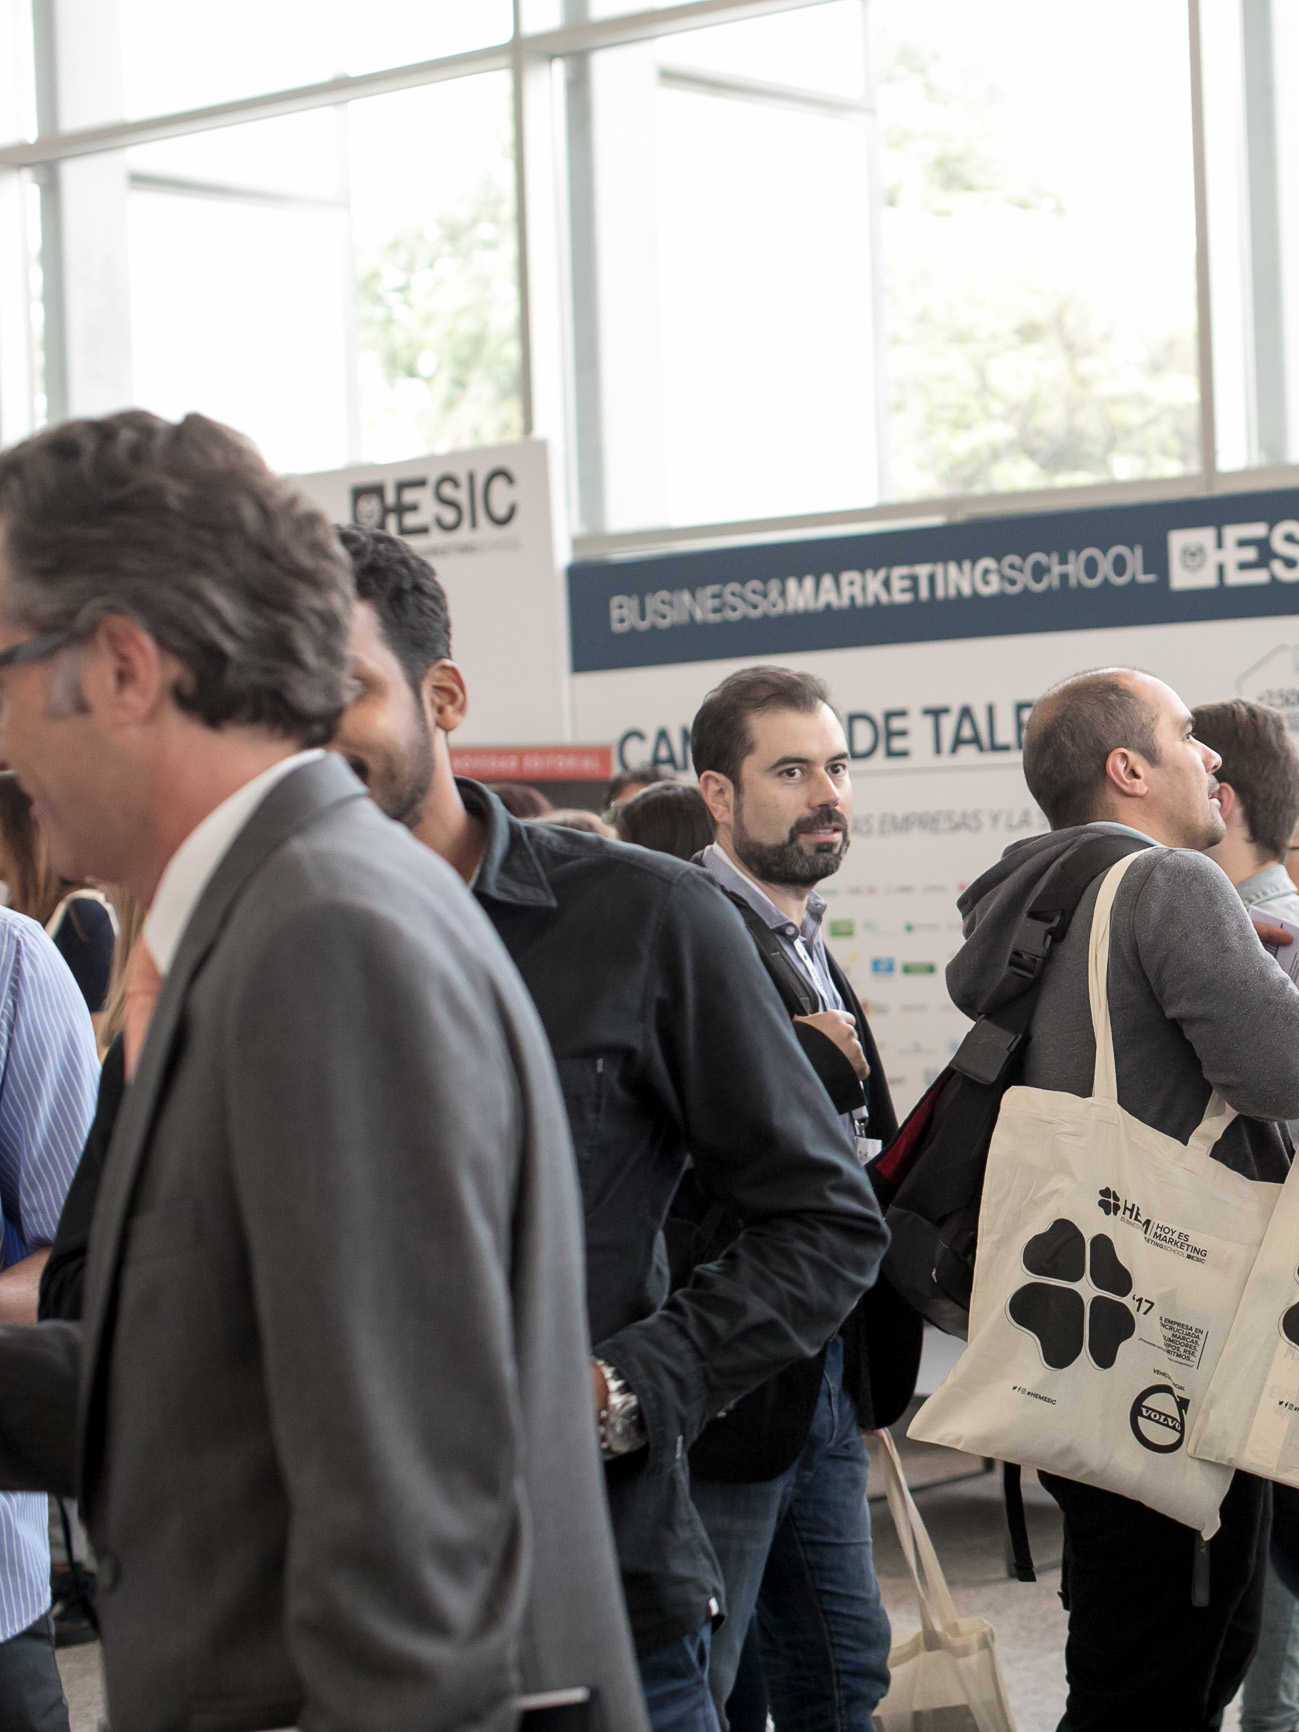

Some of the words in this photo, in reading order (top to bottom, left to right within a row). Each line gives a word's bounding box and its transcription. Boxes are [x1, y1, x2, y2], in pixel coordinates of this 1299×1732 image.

[394, 467, 517, 536] ESIC
[847, 709, 911, 760] DE
[878, 808, 984, 837] EMPRESAS
[1152, 1231, 1208, 1258] MARKETING
[1155, 1223, 1177, 1238] HOY
[1177, 1231, 1190, 1243] ES
[1164, 1317, 1193, 1332] EMPRESA
[1194, 1327, 1204, 1335] EN
[1140, 1406, 1181, 1431] VOLVO
